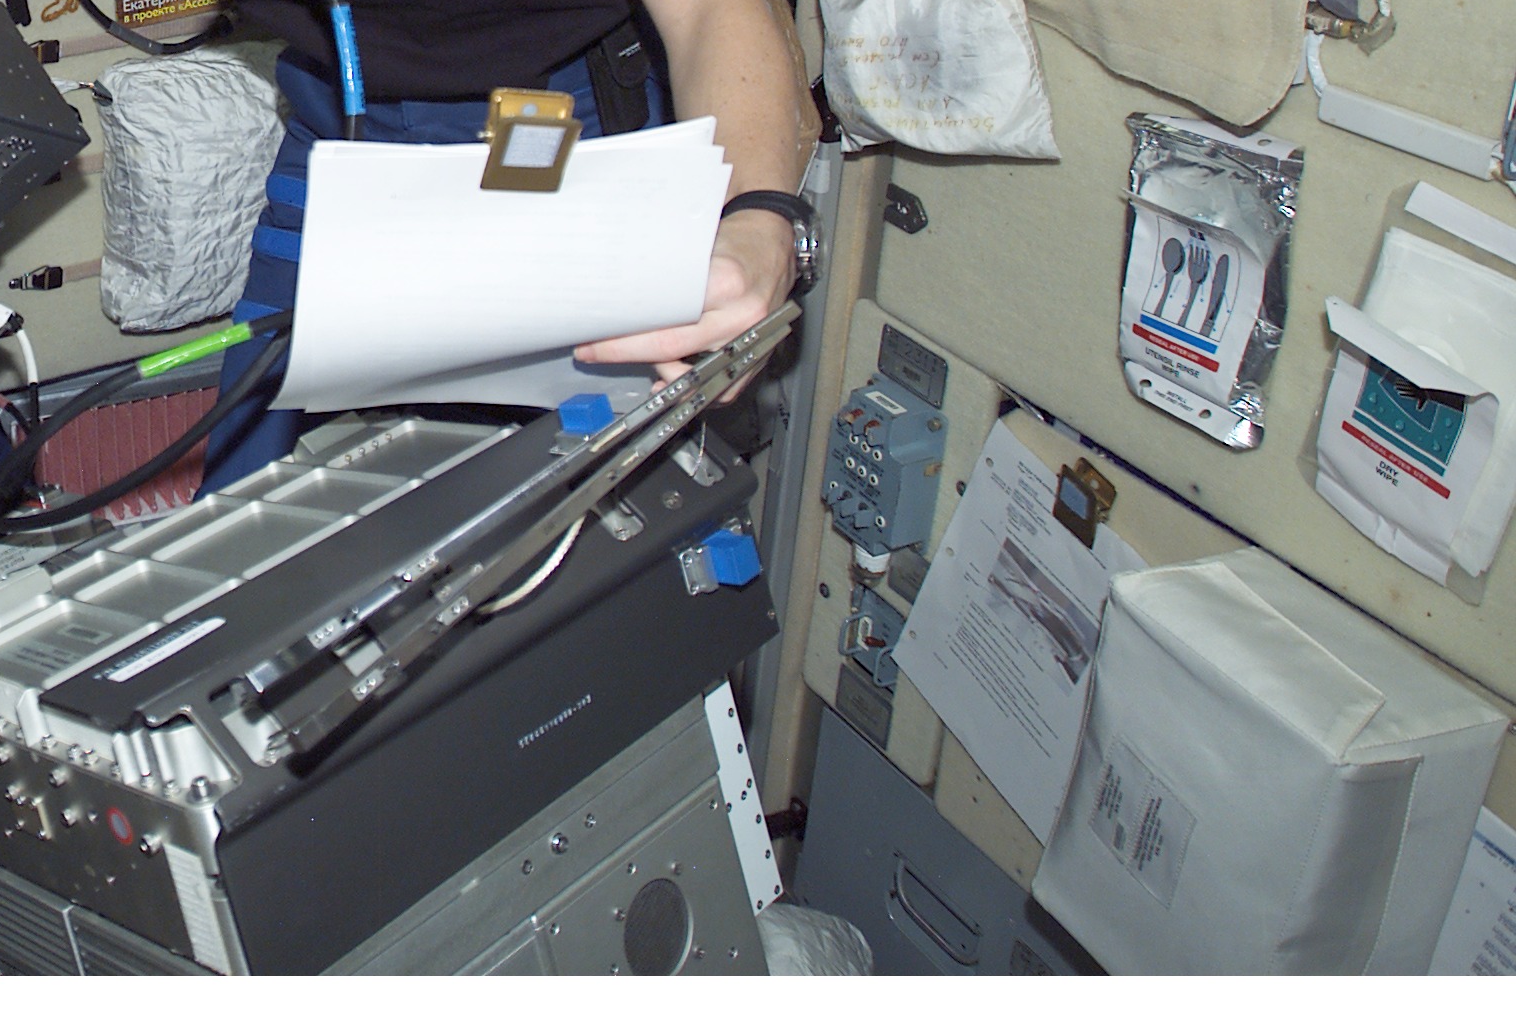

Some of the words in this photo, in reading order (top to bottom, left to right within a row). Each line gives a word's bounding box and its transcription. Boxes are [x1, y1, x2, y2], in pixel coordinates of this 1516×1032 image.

[124, 15, 130, 23] в
[133, 5, 175, 23] проекте
[1145, 347, 1174, 368] UTENSIL
[1176, 362, 1200, 379] RINSE
[1161, 364, 1180, 377] WIPE
[1375, 466, 1399, 487] WIPE
[1379, 460, 1399, 476] DRY
[1388, 454, 1412, 471] AFTER
[1413, 469, 1429, 484] USE
